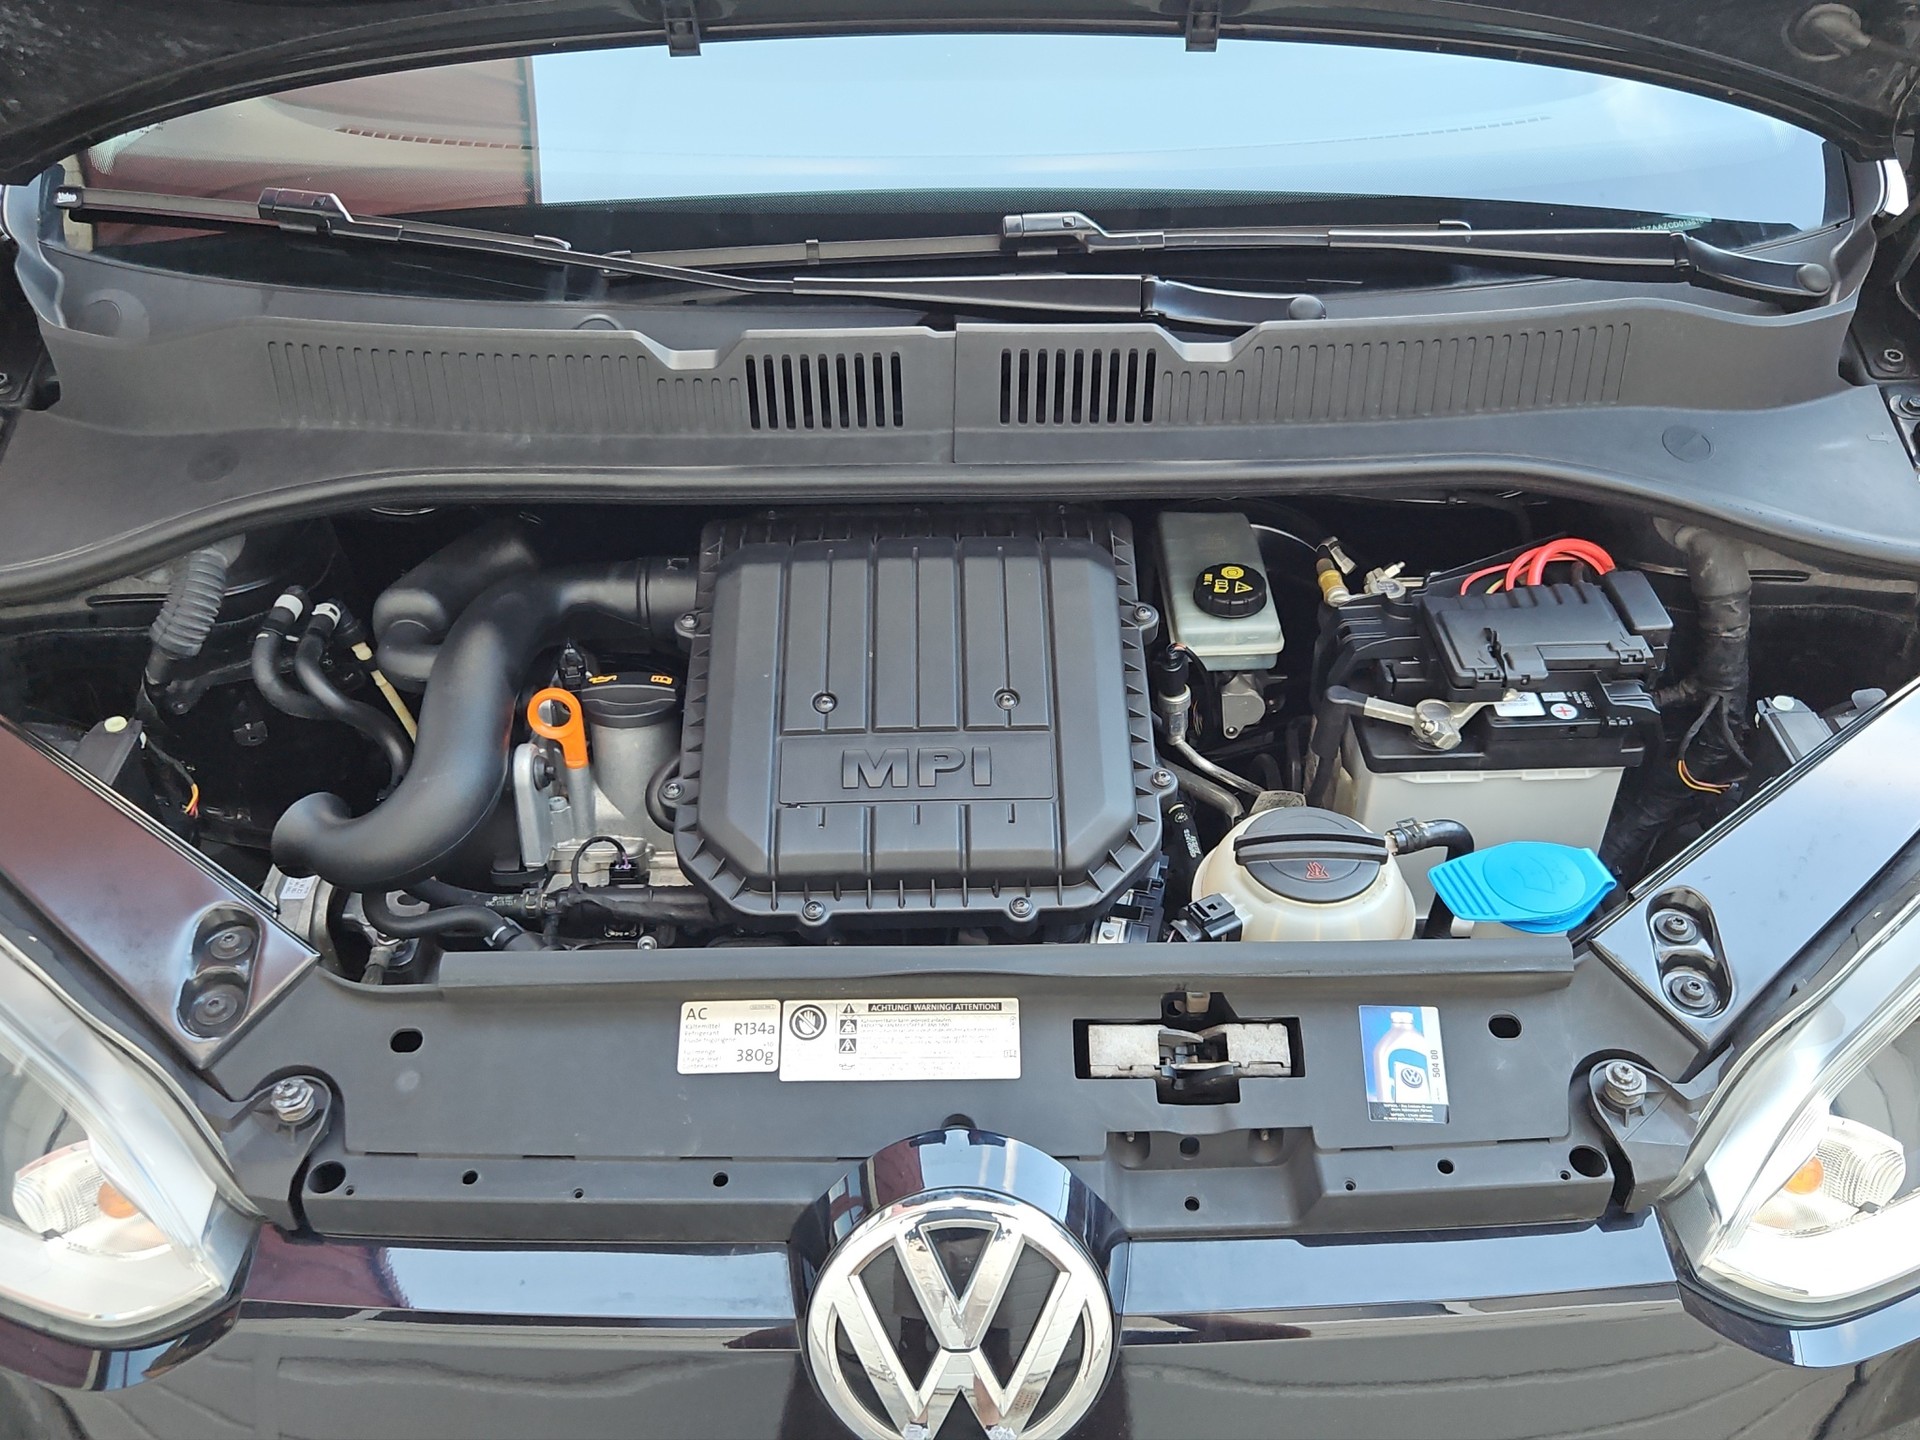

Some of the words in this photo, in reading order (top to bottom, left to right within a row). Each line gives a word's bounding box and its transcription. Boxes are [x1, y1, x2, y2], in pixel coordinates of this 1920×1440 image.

[842, 747, 992, 789] MPI
[686, 1007, 708, 1020] AC
[871, 1004, 911, 1012] ACHTUNG!
[913, 1003, 953, 1011] WARNING!
[955, 1003, 1000, 1011] ATTENTION!
[734, 1022, 775, 1035] R134a
[736, 1049, 774, 1065] 380g
[1431, 1063, 1440, 1078] 504
[810, 1190, 1112, 1440] VW
